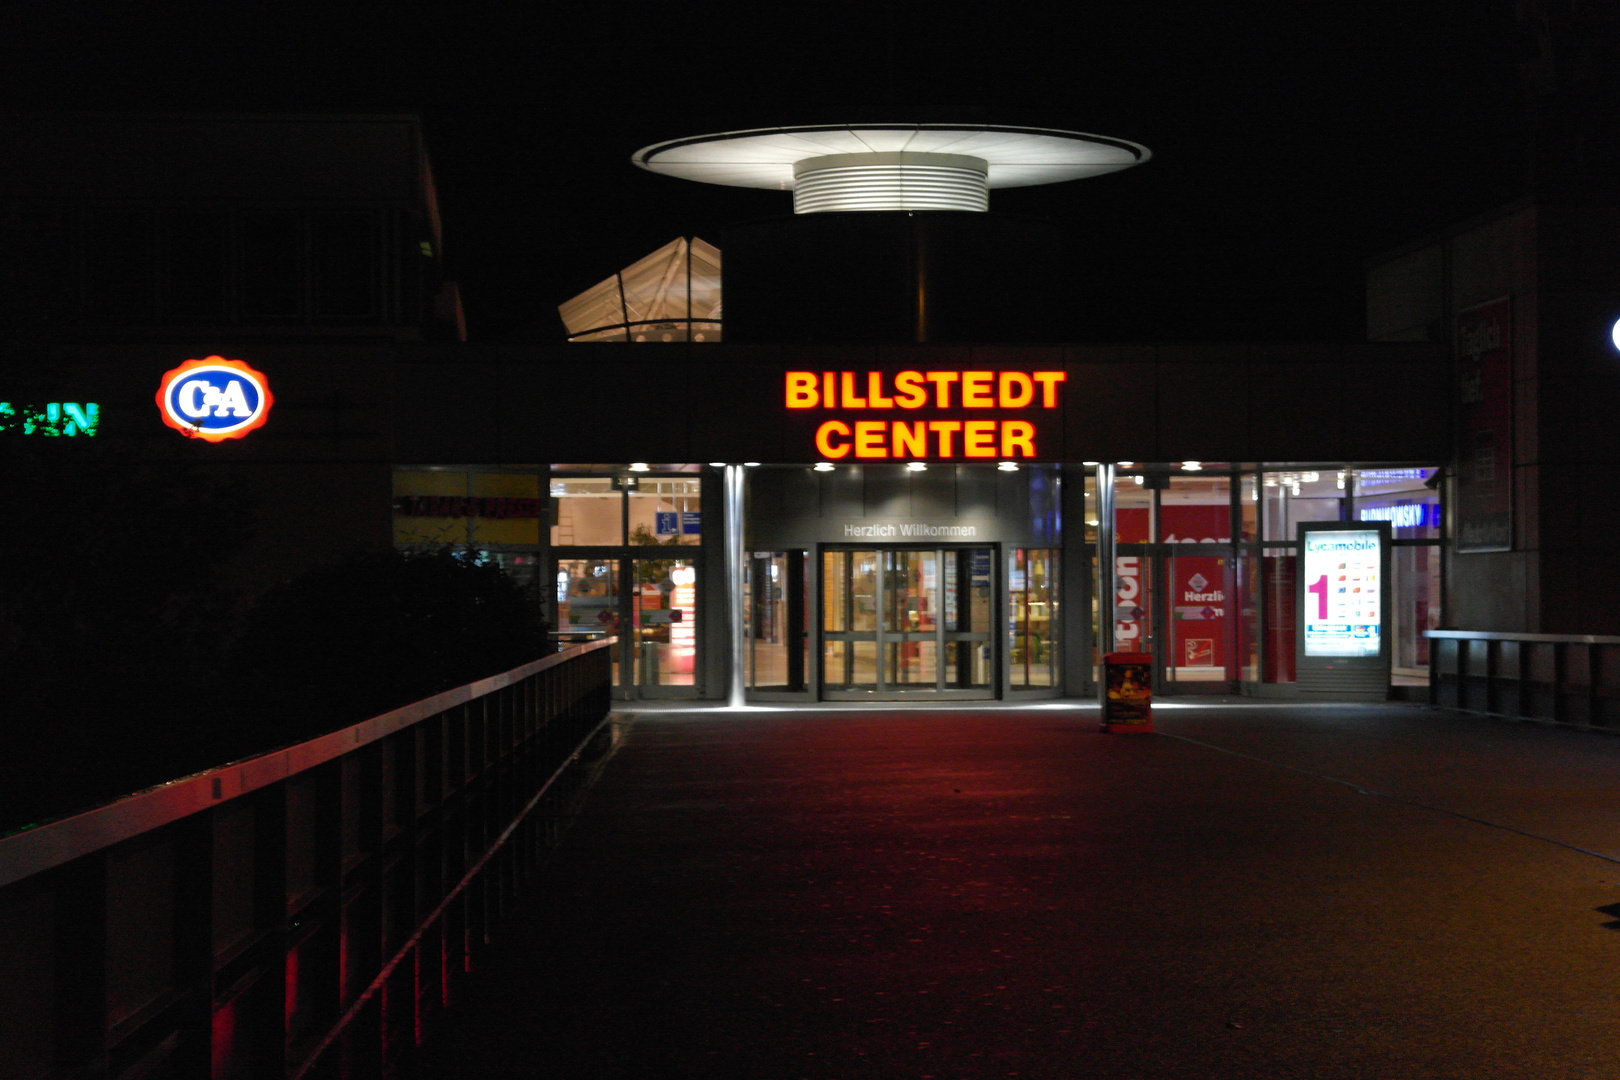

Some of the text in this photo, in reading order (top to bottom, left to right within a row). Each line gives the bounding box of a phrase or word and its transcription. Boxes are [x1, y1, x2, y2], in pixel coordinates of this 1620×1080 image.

[179, 380, 253, 417] C&A
[785, 371, 1066, 408] BILLSTEDT
[815, 420, 1037, 459] CENTER
[844, 524, 976, 537] Herzlich Willkommen
[1306, 540, 1376, 553] Lycamobile
[1307, 575, 1328, 619] 1
